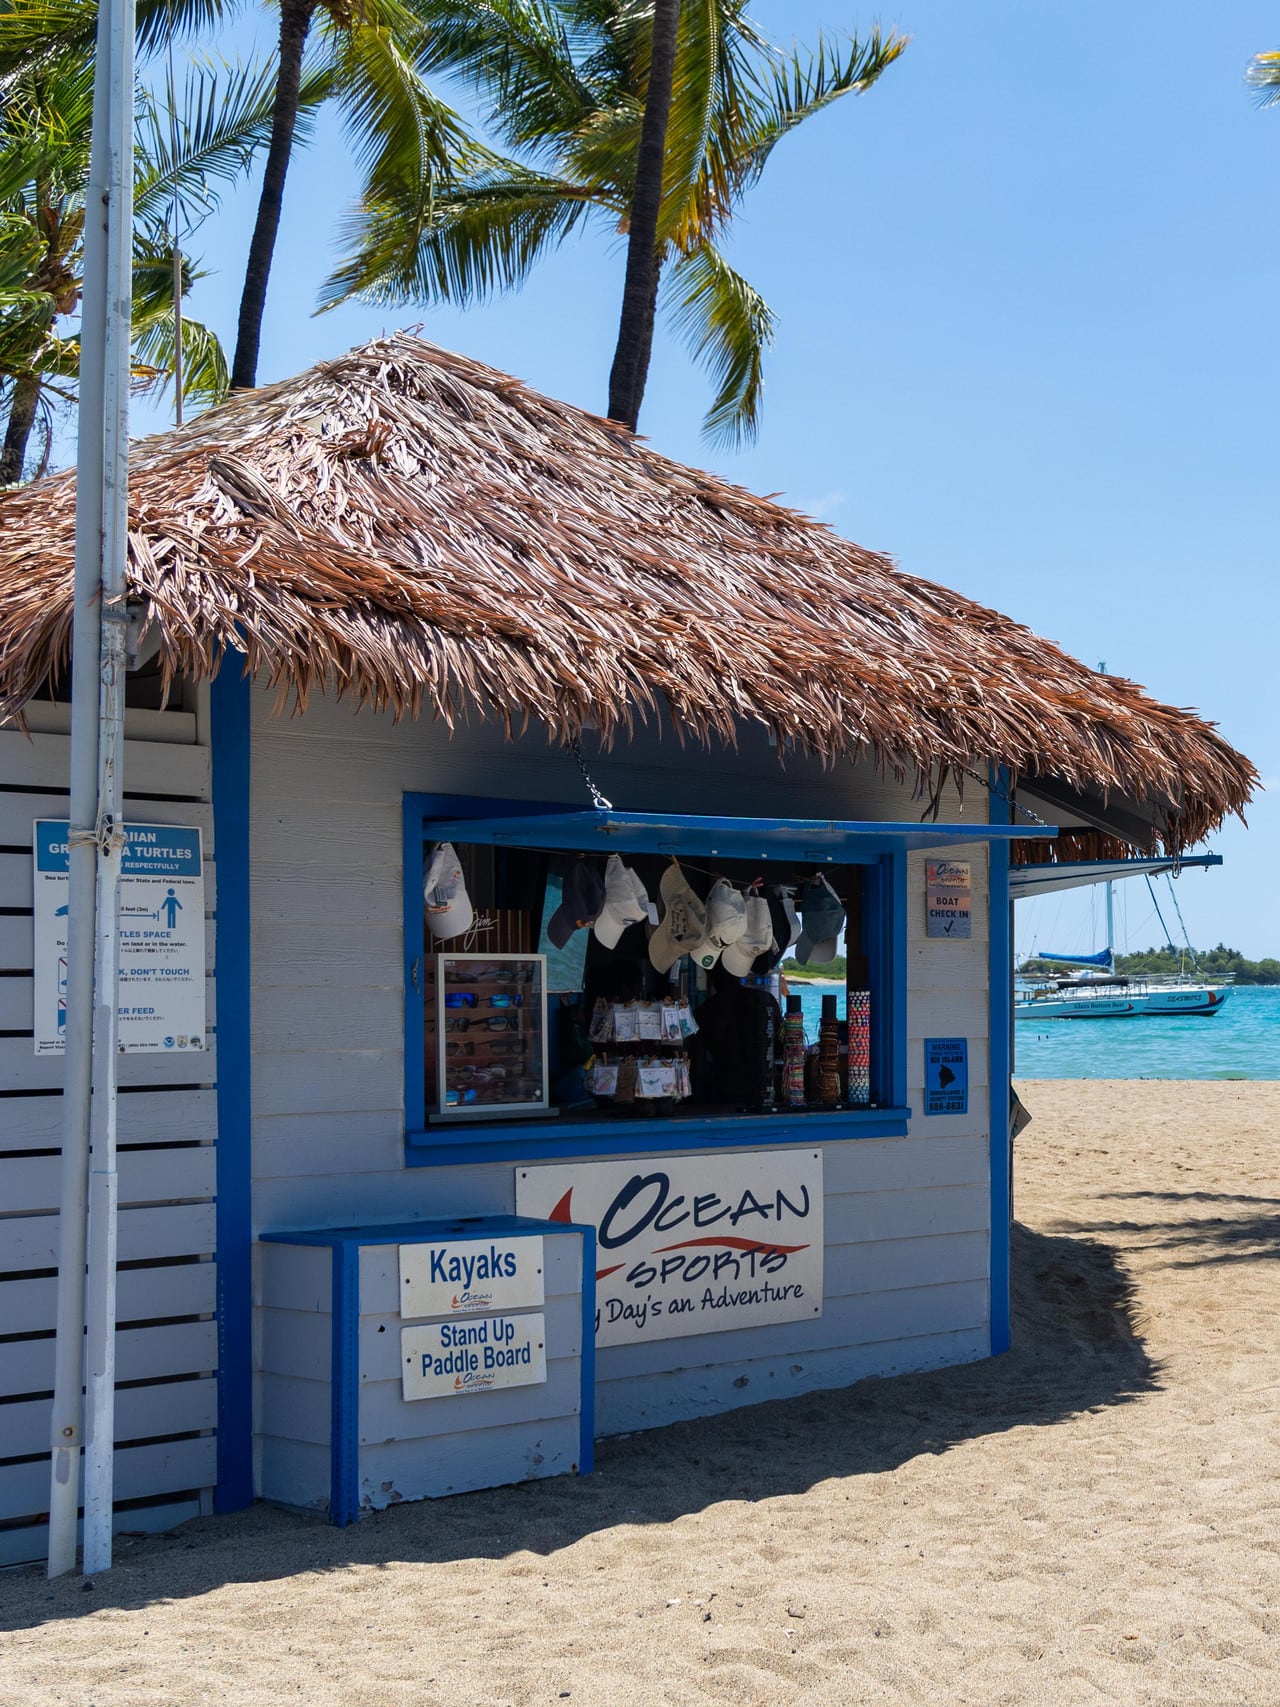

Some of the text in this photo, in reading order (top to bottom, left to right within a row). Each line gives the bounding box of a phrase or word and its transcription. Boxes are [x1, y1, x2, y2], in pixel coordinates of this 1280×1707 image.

[134, 846, 193, 859] TURTLES
[125, 862, 180, 870] RESPECTFULLY
[936, 863, 969, 876] OCEAN
[936, 897, 959, 906] BOAT
[930, 909, 957, 918] CHECK
[130, 968, 158, 976] DON'T
[160, 968, 190, 976] TOUCH
[132, 1007, 155, 1015] FEED
[598, 1172, 811, 1249] OCEAN
[430, 1245, 517, 1290] Kayaks
[626, 1246, 788, 1289] SPORTS
[607, 1296, 663, 1328] Day's
[668, 1298, 695, 1314] an
[701, 1282, 805, 1308] Adventure
[440, 1318, 515, 1348] Stand Up
[421, 1341, 532, 1377] Paddle Board
